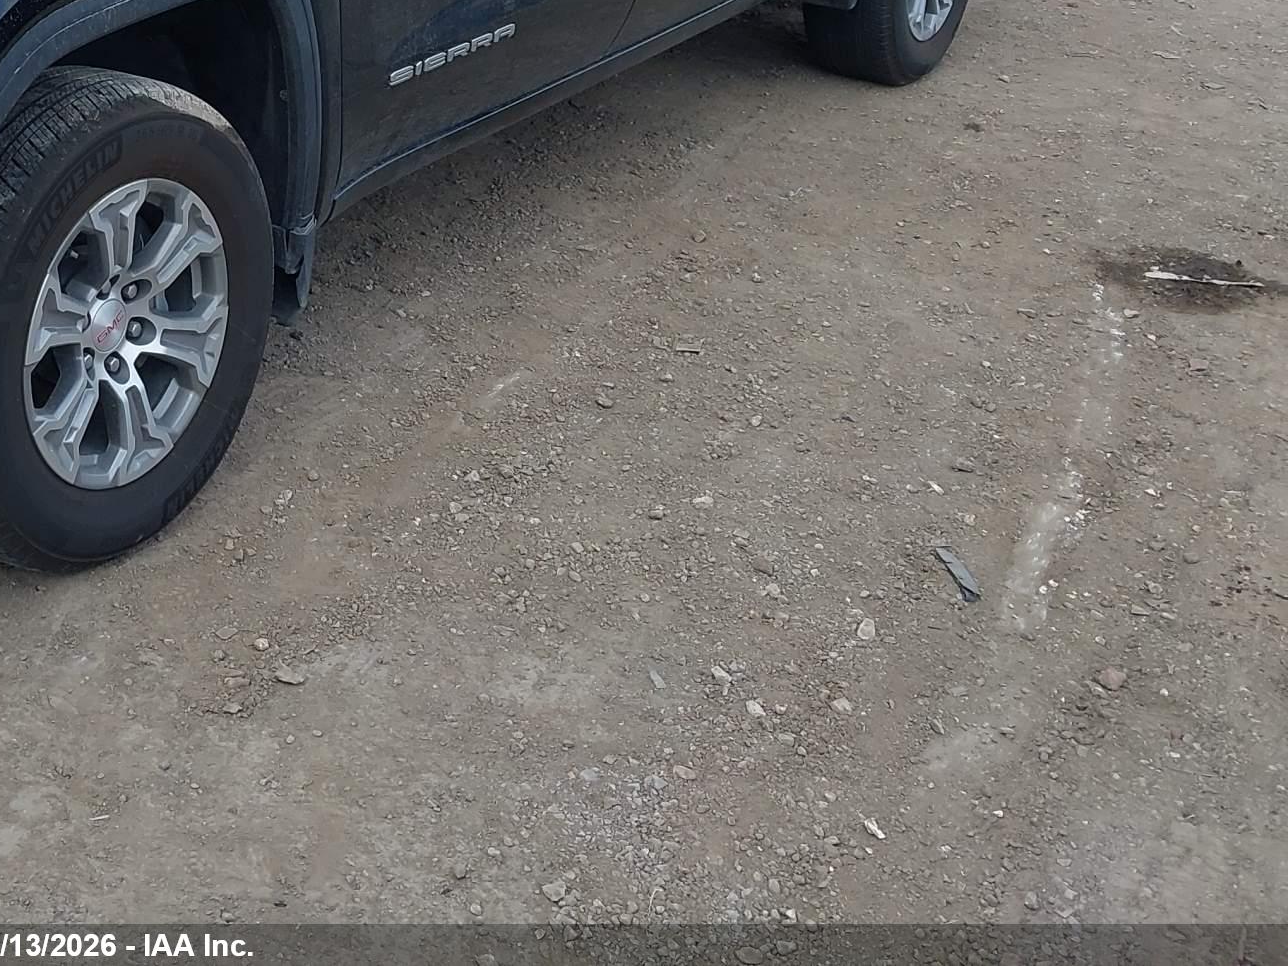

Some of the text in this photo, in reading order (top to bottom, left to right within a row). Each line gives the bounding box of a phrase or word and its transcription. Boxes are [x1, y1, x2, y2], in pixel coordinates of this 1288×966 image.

[389, 23, 516, 87] SIERRA
[26, 140, 120, 258] MICHELIN
[96, 309, 125, 344] GMC
